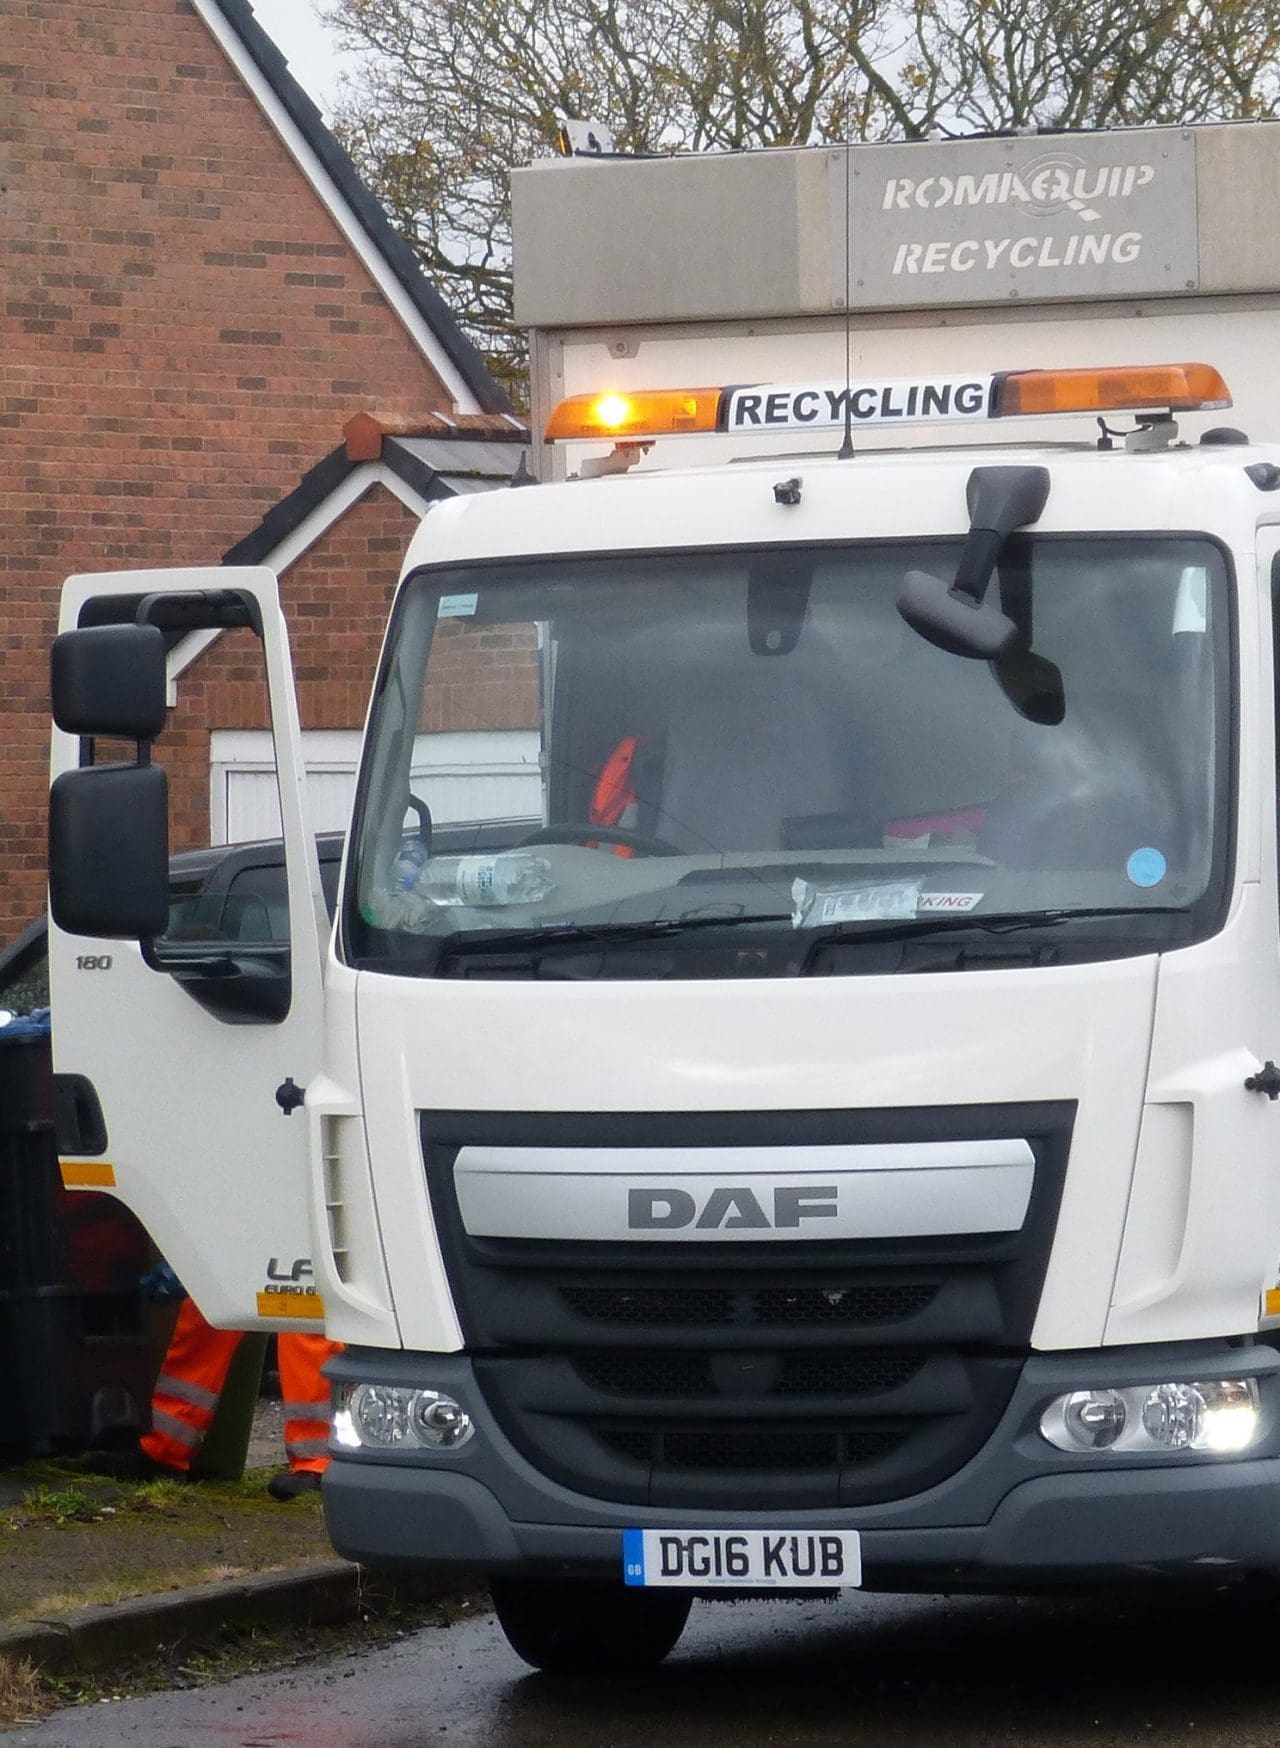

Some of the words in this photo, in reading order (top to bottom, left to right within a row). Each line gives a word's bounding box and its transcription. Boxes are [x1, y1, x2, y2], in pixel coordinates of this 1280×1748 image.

[882, 164, 1156, 221] ROMAQUIP
[892, 231, 1143, 275] RECYCLING
[734, 383, 984, 426] RECYCLING
[920, 895, 974, 908] KING
[76, 955, 112, 970] 180
[628, 1185, 838, 1230] DAF
[267, 1257, 313, 1282] LF
[627, 1563, 642, 1576] GB
[659, 1536, 750, 1578] DG16
[763, 1536, 844, 1578] KUB
